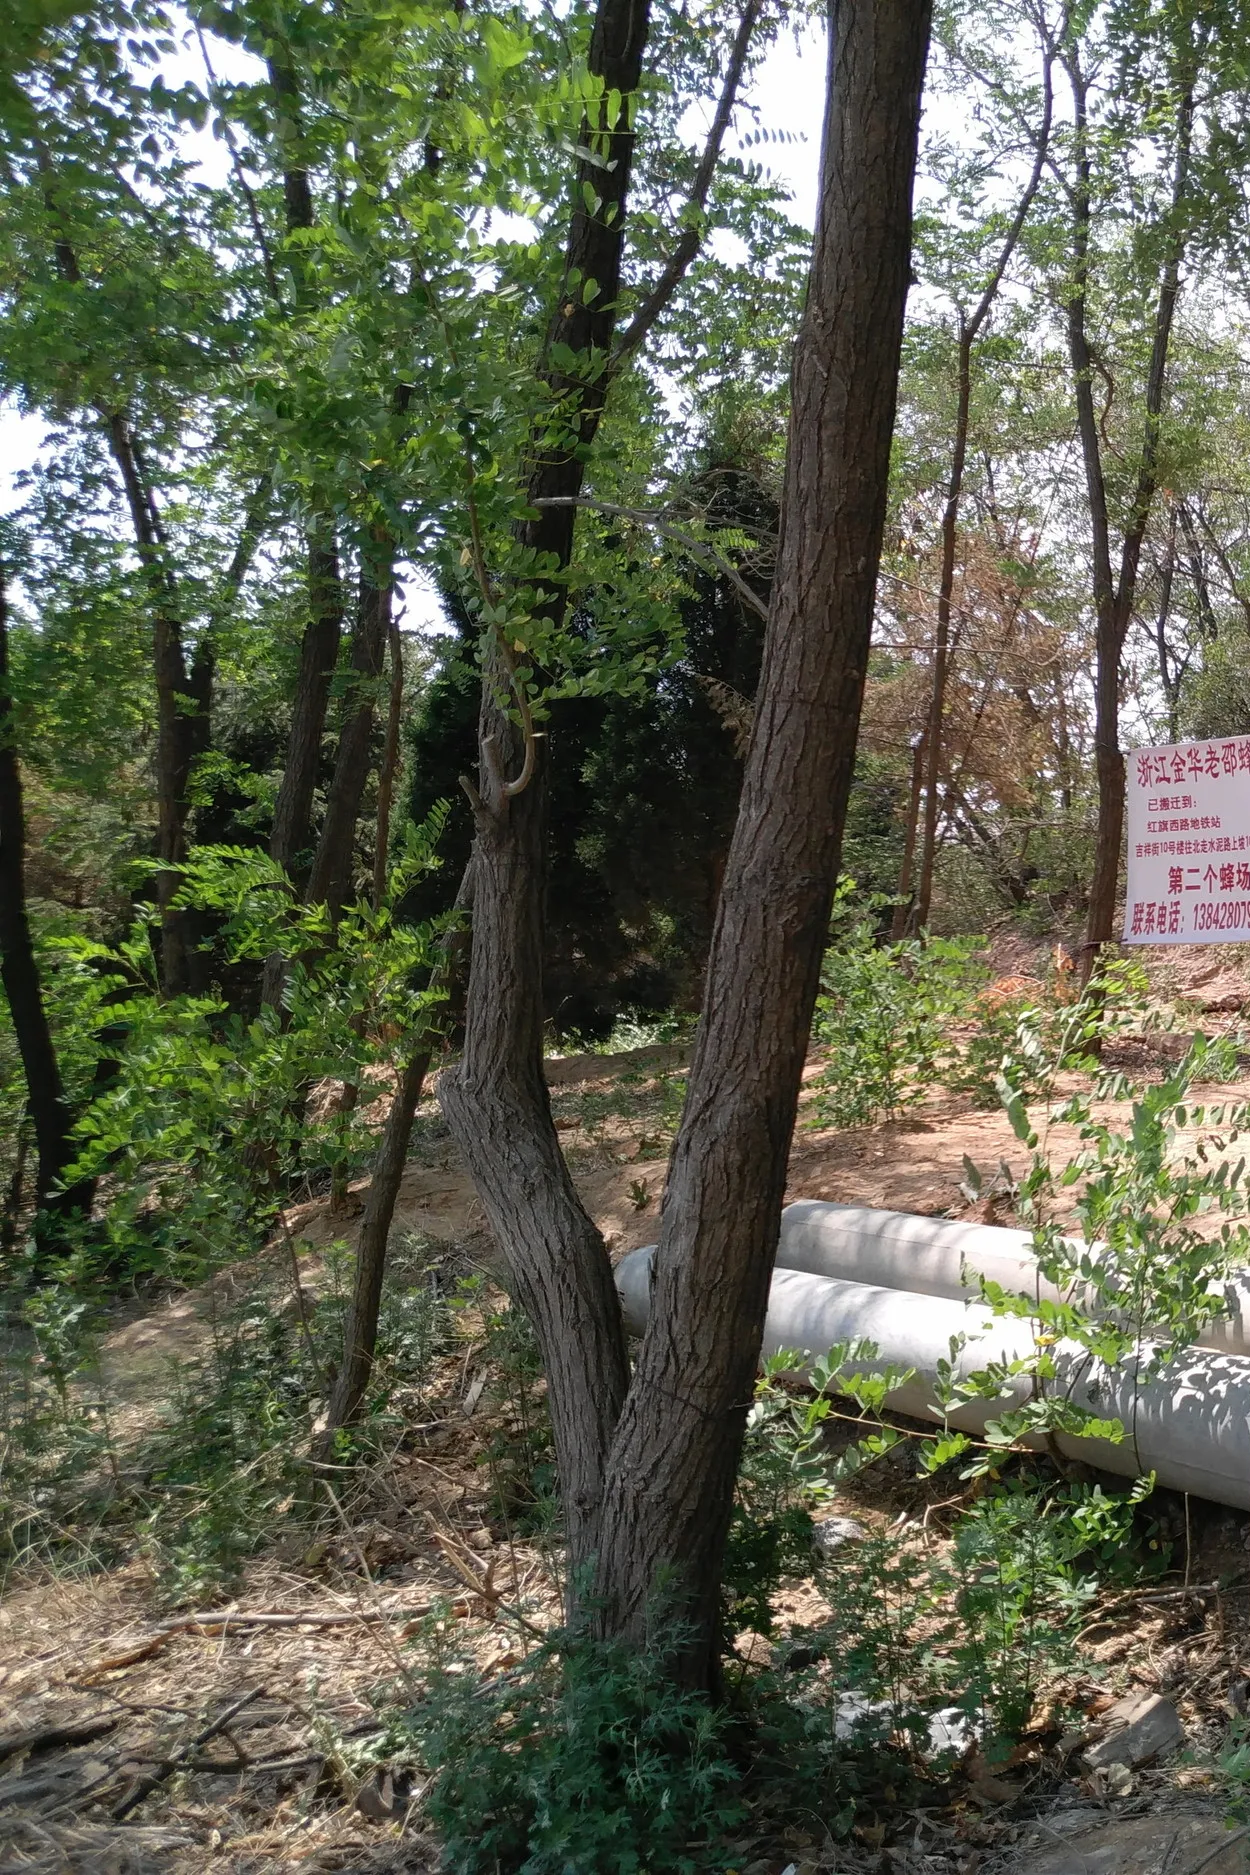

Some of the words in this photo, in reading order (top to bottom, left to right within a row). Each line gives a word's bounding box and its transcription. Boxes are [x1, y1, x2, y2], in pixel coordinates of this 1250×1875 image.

[1147, 816, 1221, 832] 红旗西路地铁站
